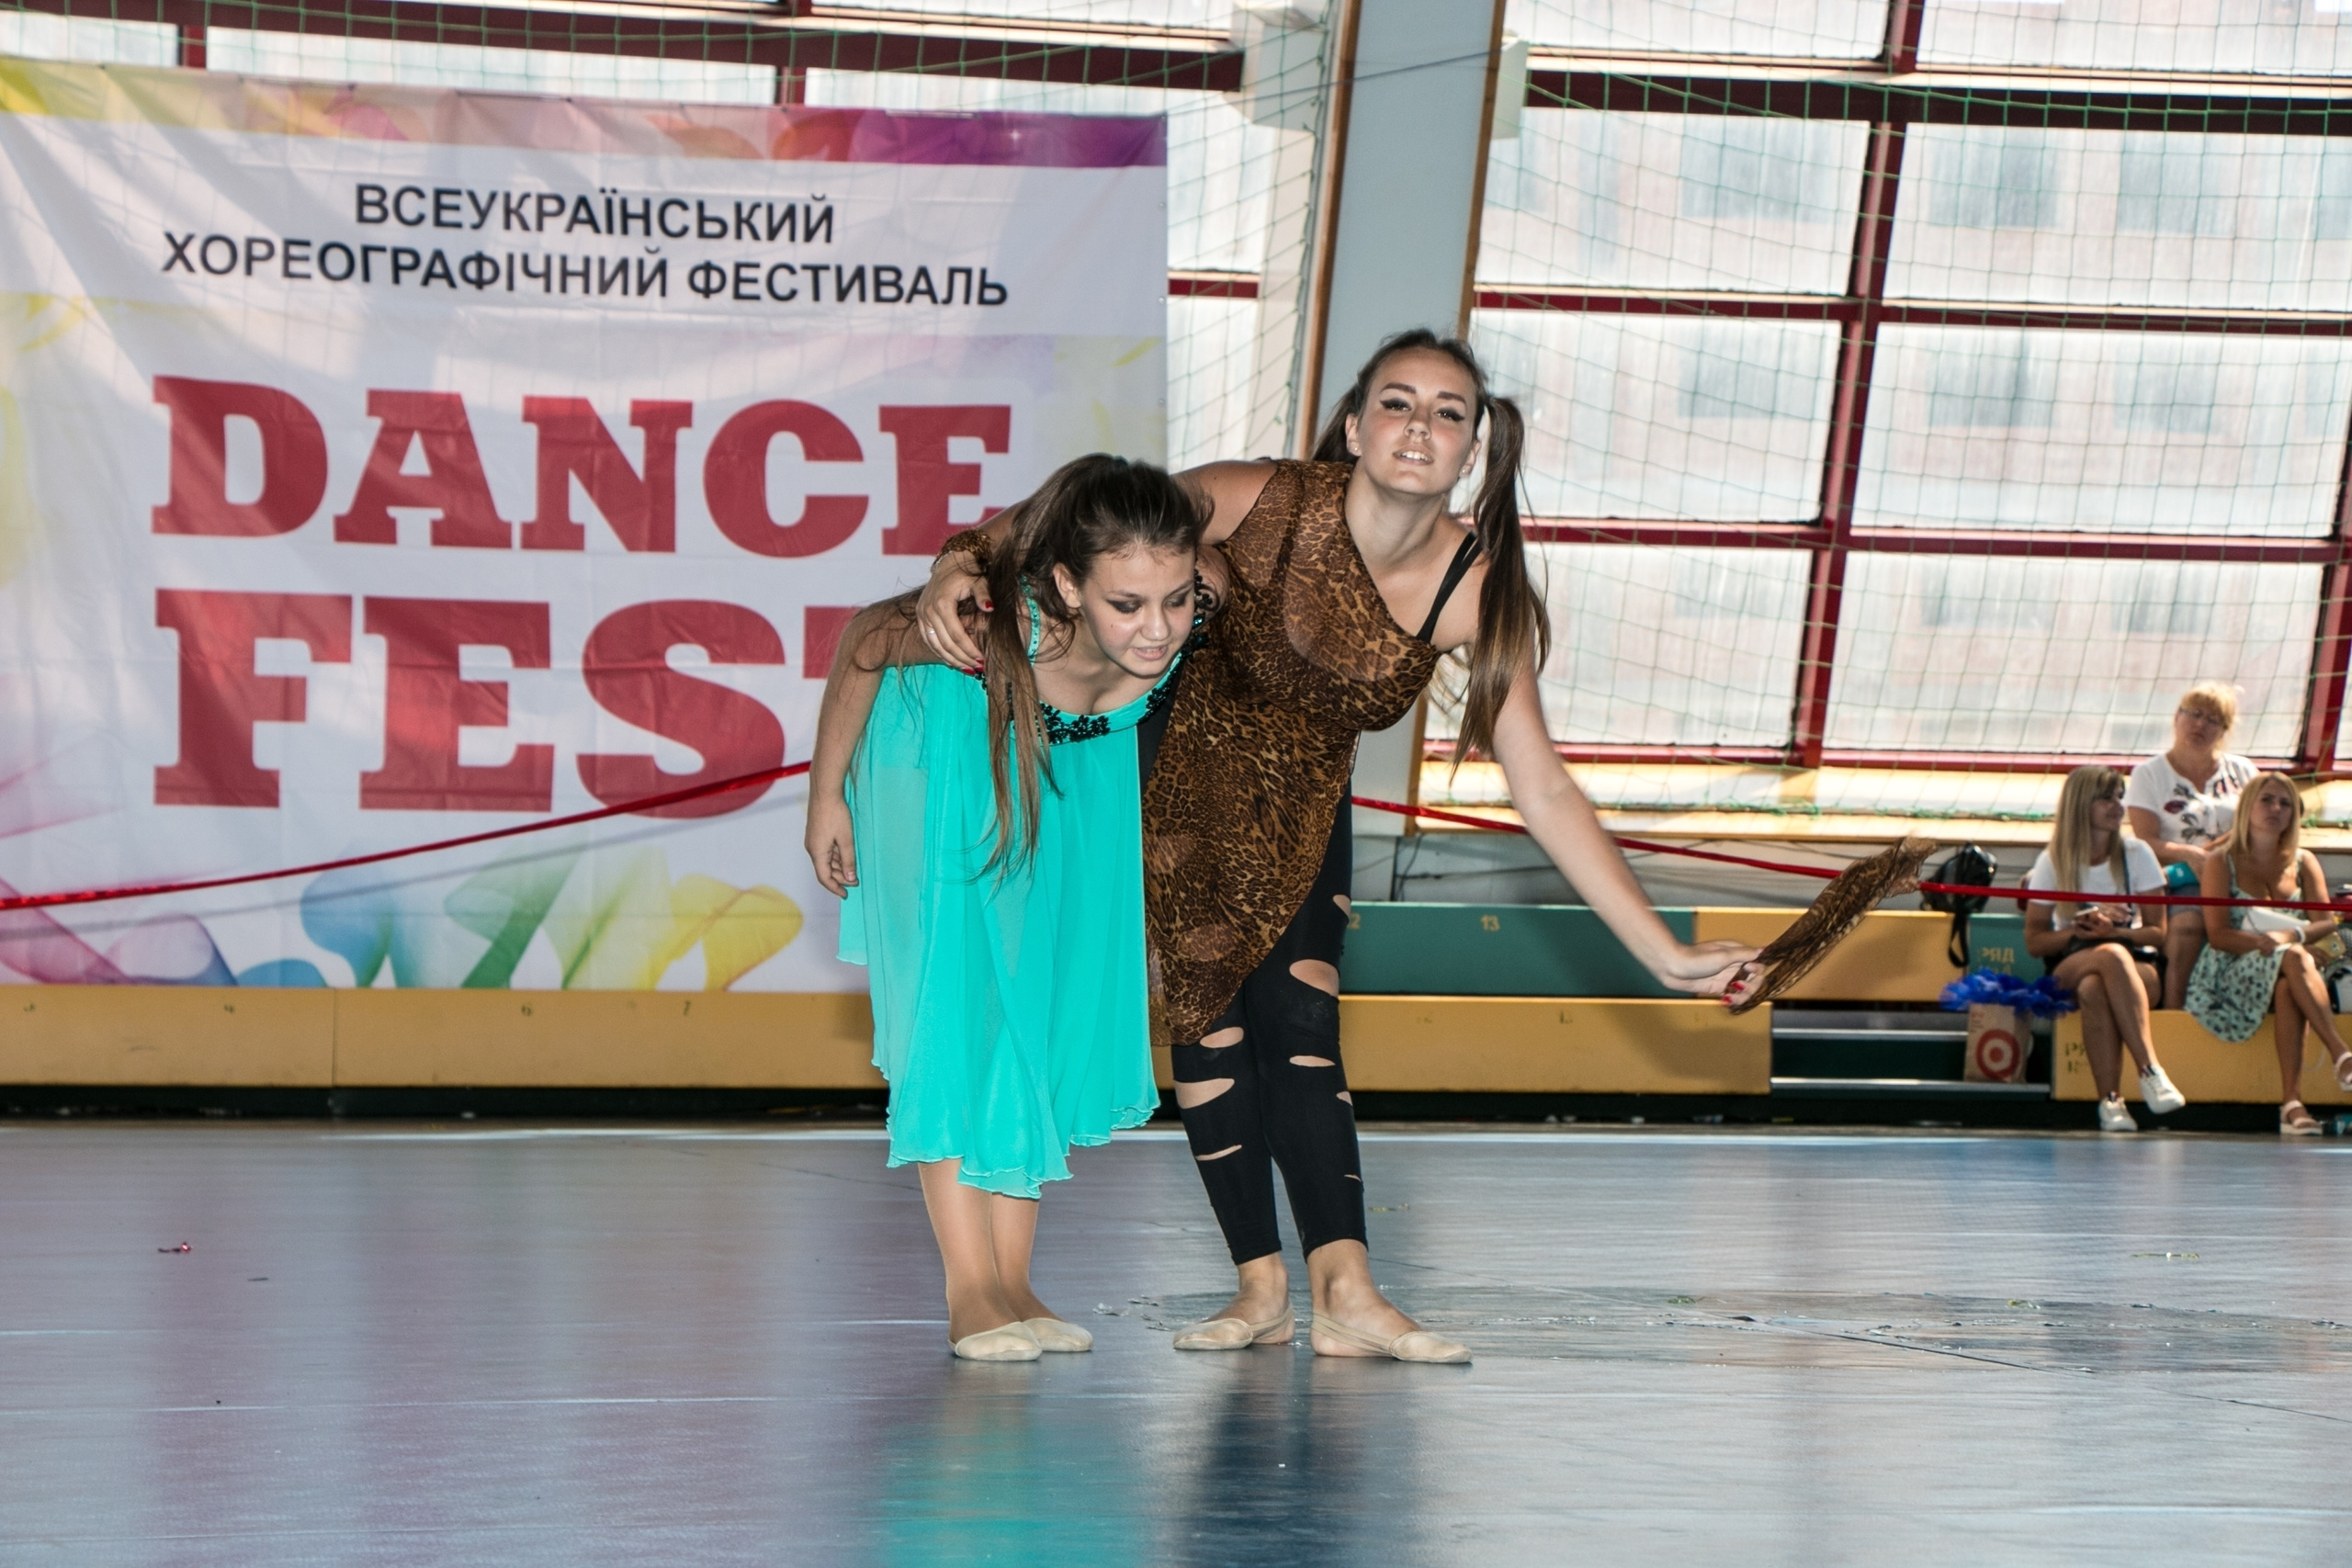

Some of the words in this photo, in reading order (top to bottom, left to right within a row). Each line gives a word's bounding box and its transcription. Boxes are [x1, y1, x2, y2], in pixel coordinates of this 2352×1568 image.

[356, 184, 834, 244] ВСЕУКРАЇНСЬКИЙ
[163, 231, 669, 299] ХОРЕОГРАФІЧНИЙ
[687, 261, 1010, 307] ФЕСТИВАЛЬ
[152, 375, 1012, 559] DANCE
[154, 587, 860, 819] FES
[1480, 915, 1499, 931] 13
